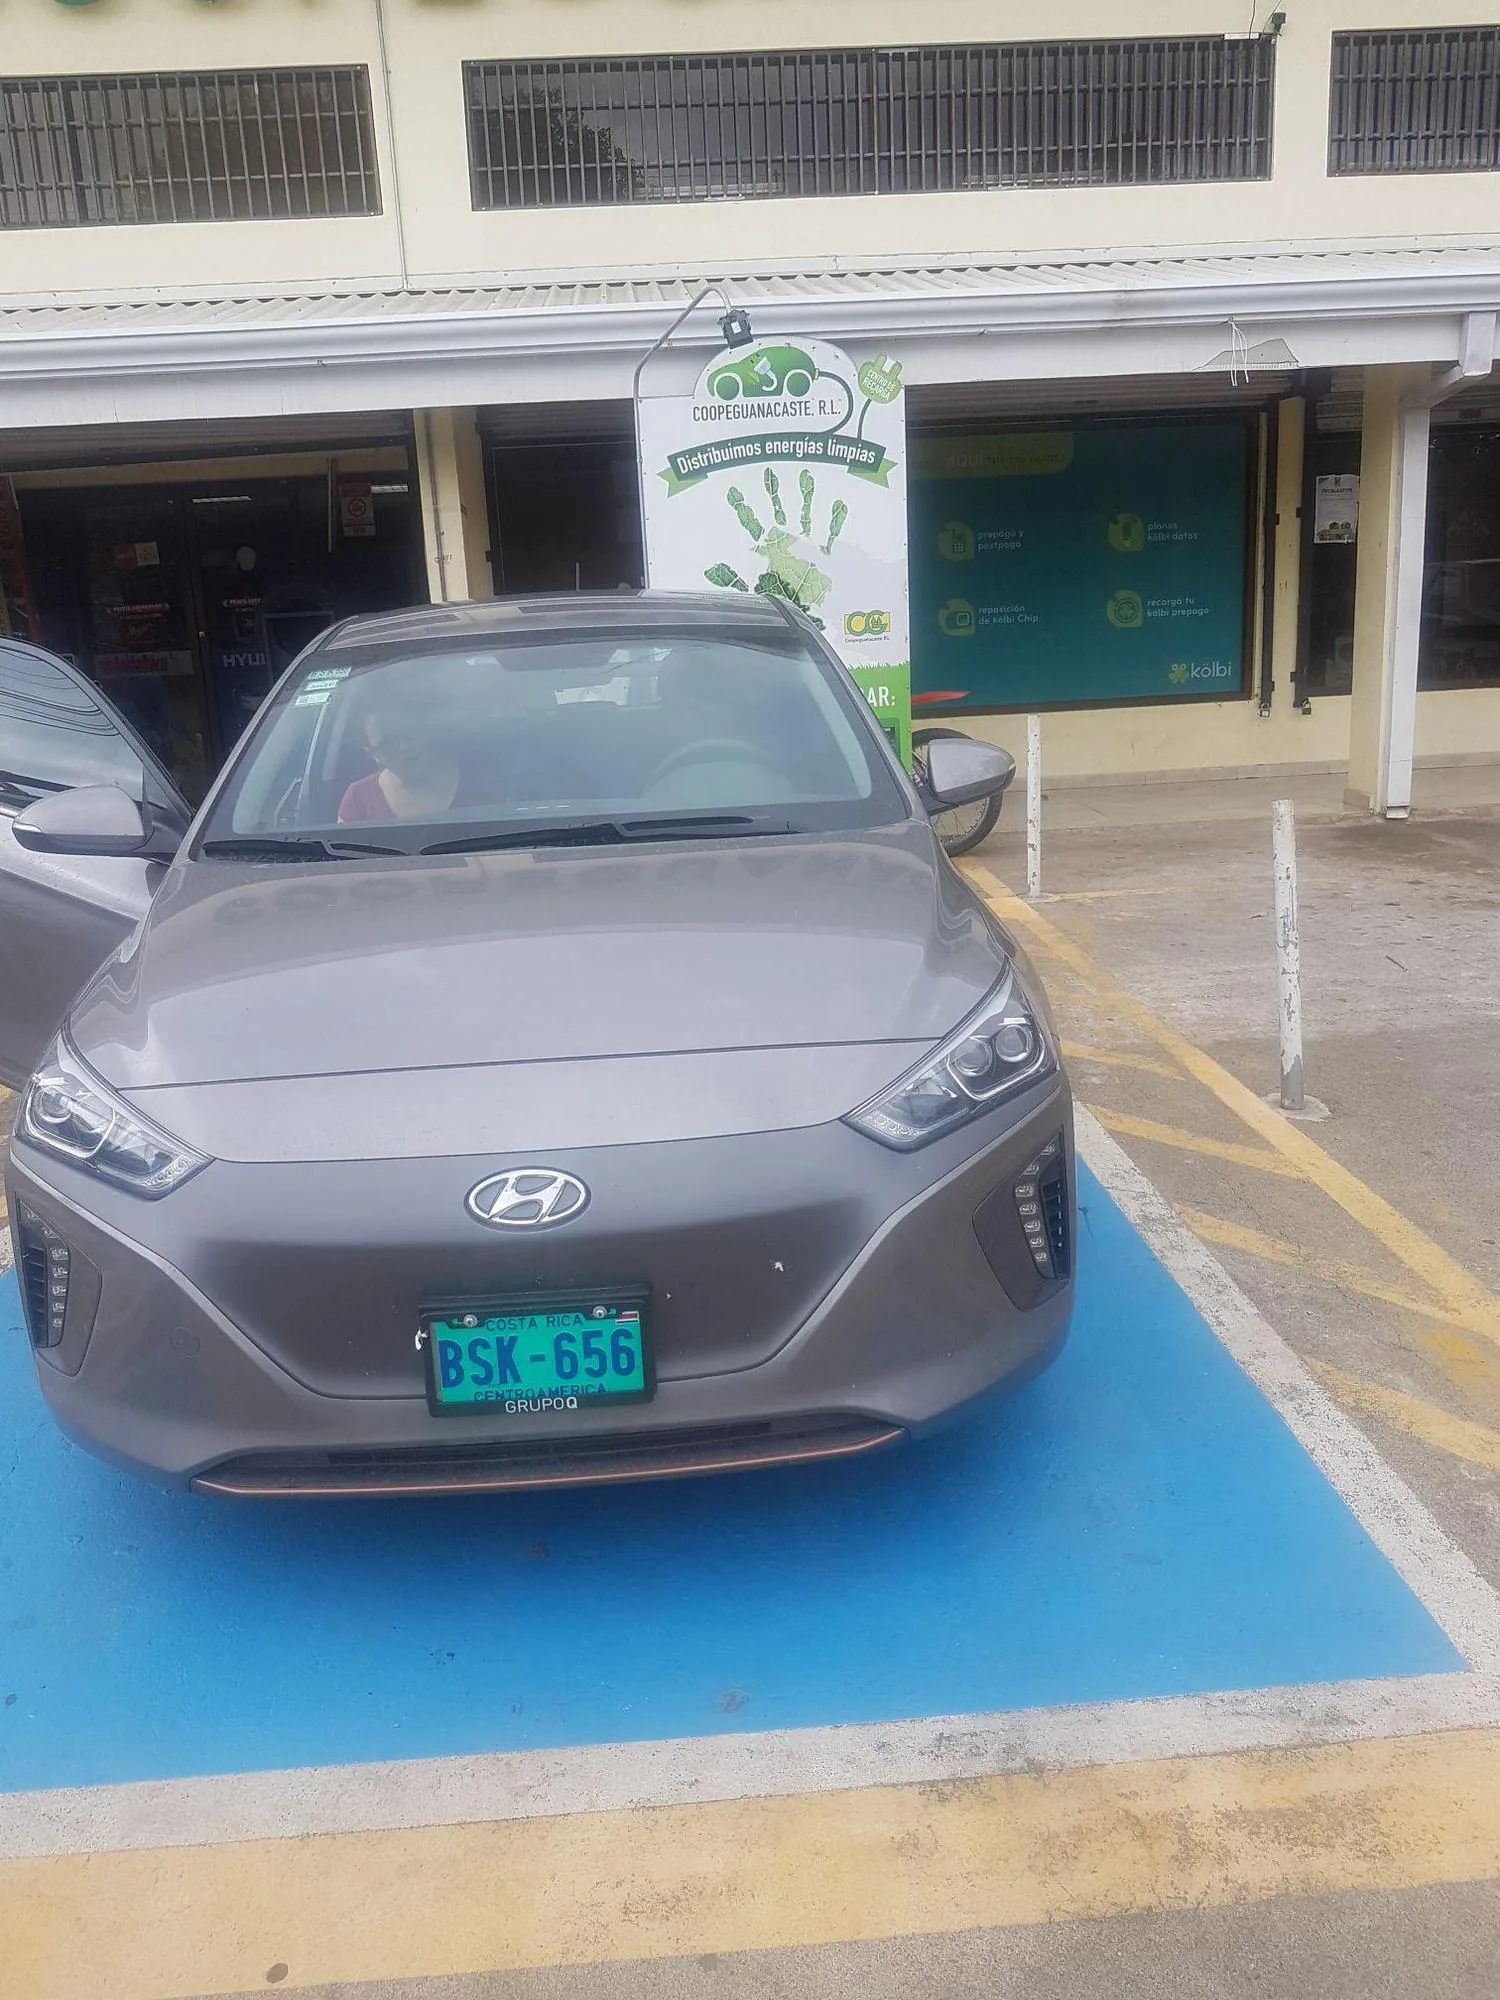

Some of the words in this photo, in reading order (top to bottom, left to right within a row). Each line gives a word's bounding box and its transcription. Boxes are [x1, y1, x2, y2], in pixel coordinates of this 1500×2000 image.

[863, 376, 891, 400] RECARGA
[818, 400, 841, 416] R.L.
[677, 441, 762, 474] Distribuimos
[765, 437, 824, 457] energías
[827, 438, 876, 464] limpias
[977, 530, 1016, 540] prepago
[1018, 529, 1024, 539] y
[1172, 532, 1199, 541] datos
[978, 541, 1022, 552] postpago
[1185, 597, 1194, 605] tu
[978, 605, 1025, 616] reposición
[1171, 608, 1209, 617] prepago
[978, 616, 990, 625] de
[1017, 613, 1039, 624] Chip
[1191, 661, 1232, 678] kölbi
[485, 1315, 539, 1331] COSTA
[546, 1313, 583, 1327] RICA
[438, 1328, 635, 1389] BSK-656
[474, 1383, 606, 1401] CENTROAMERICA
